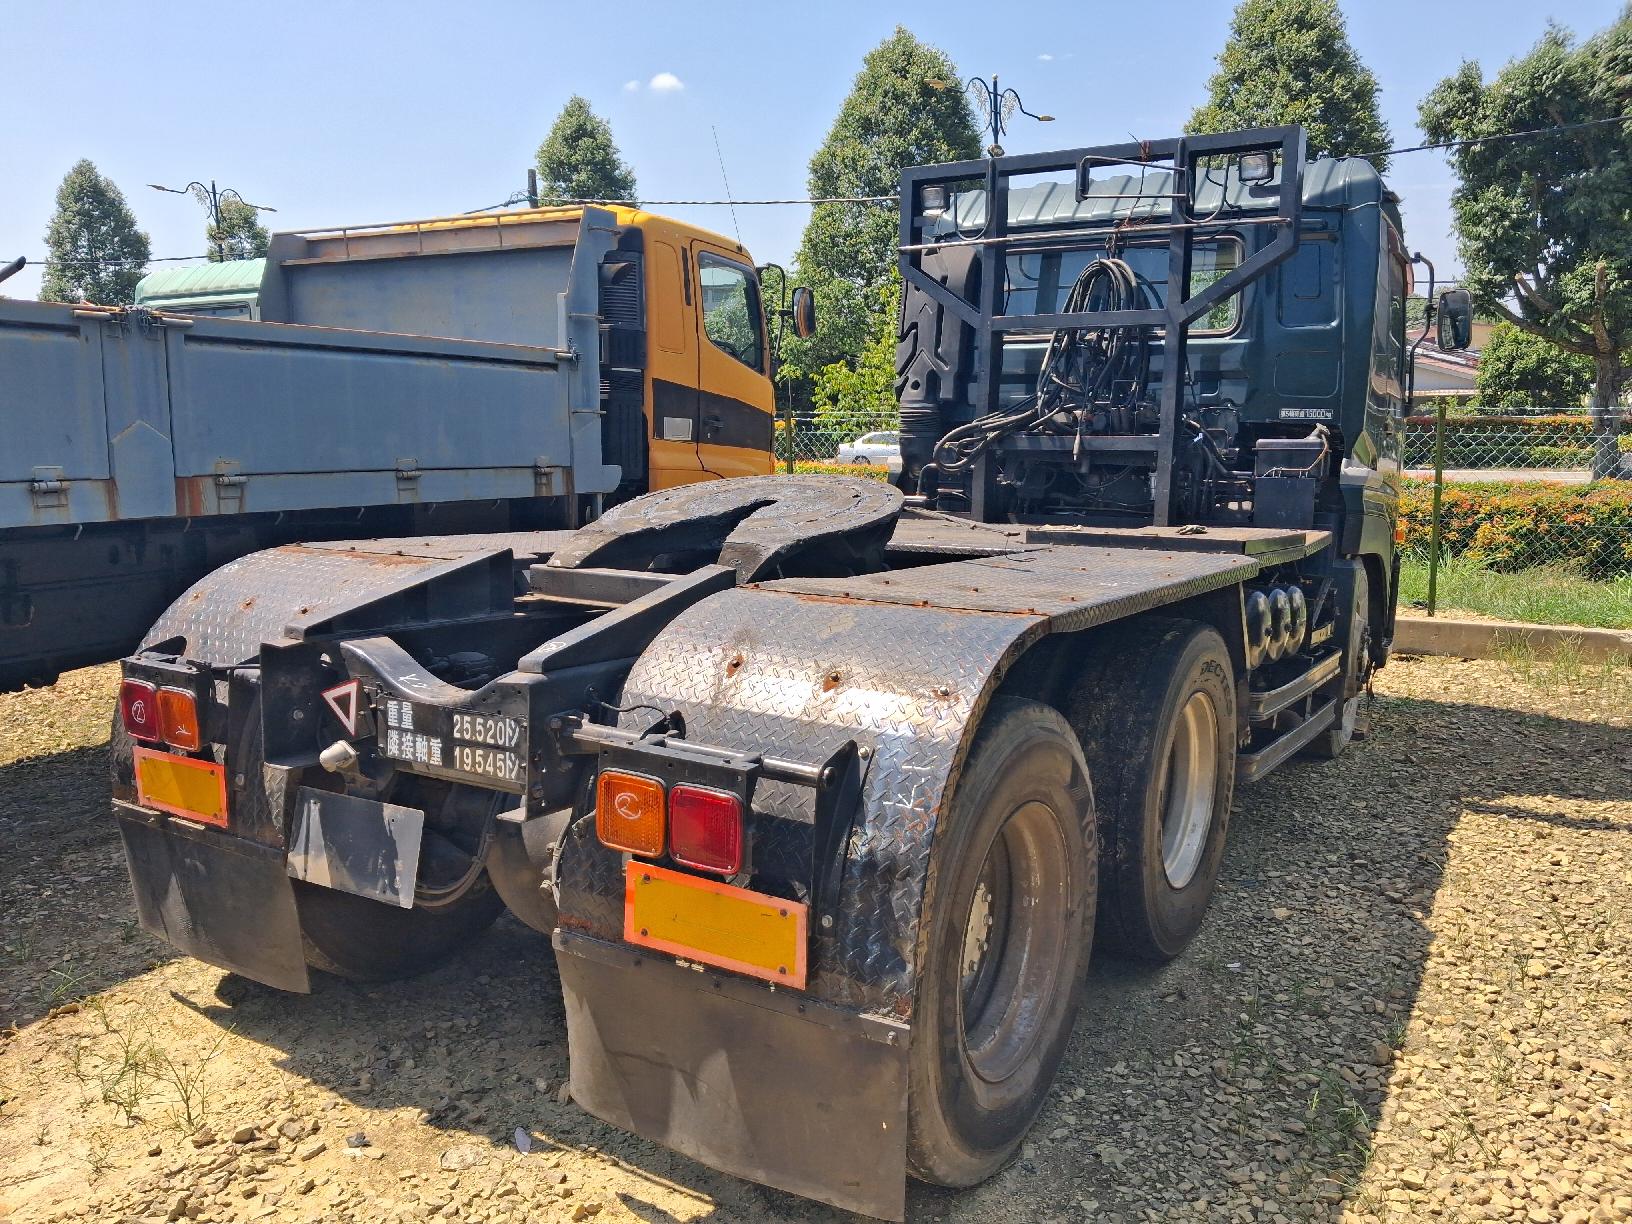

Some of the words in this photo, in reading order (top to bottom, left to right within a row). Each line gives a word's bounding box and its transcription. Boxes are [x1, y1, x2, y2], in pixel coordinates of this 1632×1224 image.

[387, 700, 413, 729] 重量
[453, 714, 520, 748] 25.520トン
[453, 746, 520, 779] 19.545トン
